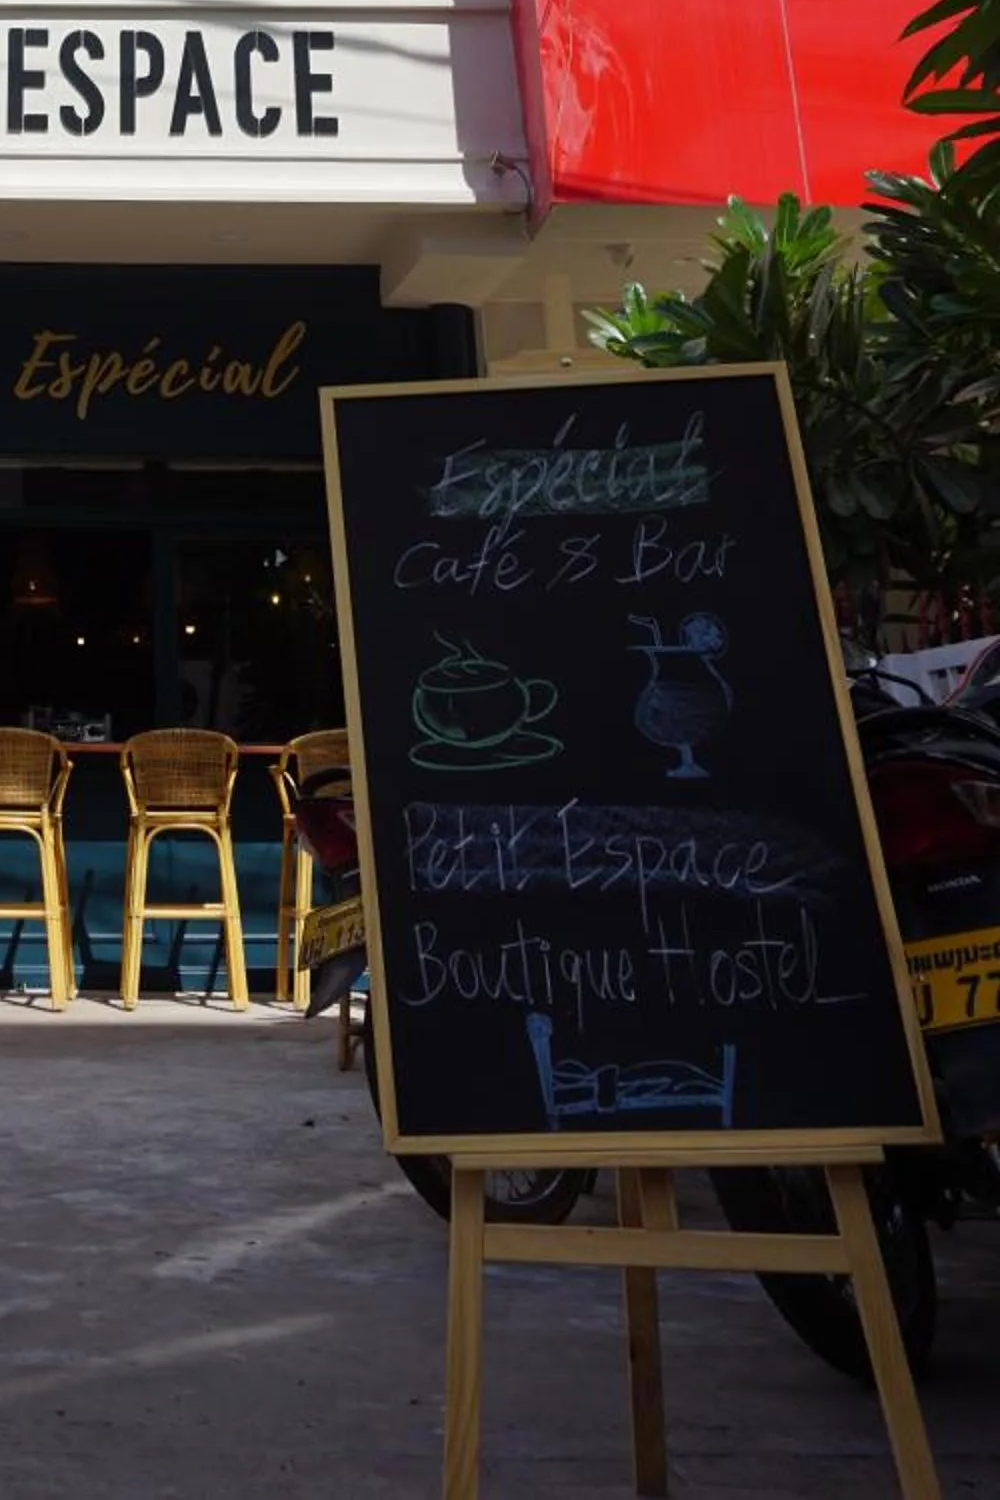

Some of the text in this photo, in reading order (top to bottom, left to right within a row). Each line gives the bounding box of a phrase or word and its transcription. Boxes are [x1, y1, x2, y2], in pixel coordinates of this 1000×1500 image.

[6, 27, 339, 139] ESPACE
[12, 320, 307, 421] Espécial
[393, 526, 533, 597] Café
[615, 515, 737, 585] Bar
[401, 797, 796, 934] Petit Espace
[927, 873, 982, 893] HONDA
[403, 918, 636, 1031] Boutique
[647, 898, 866, 1011] Hostel
